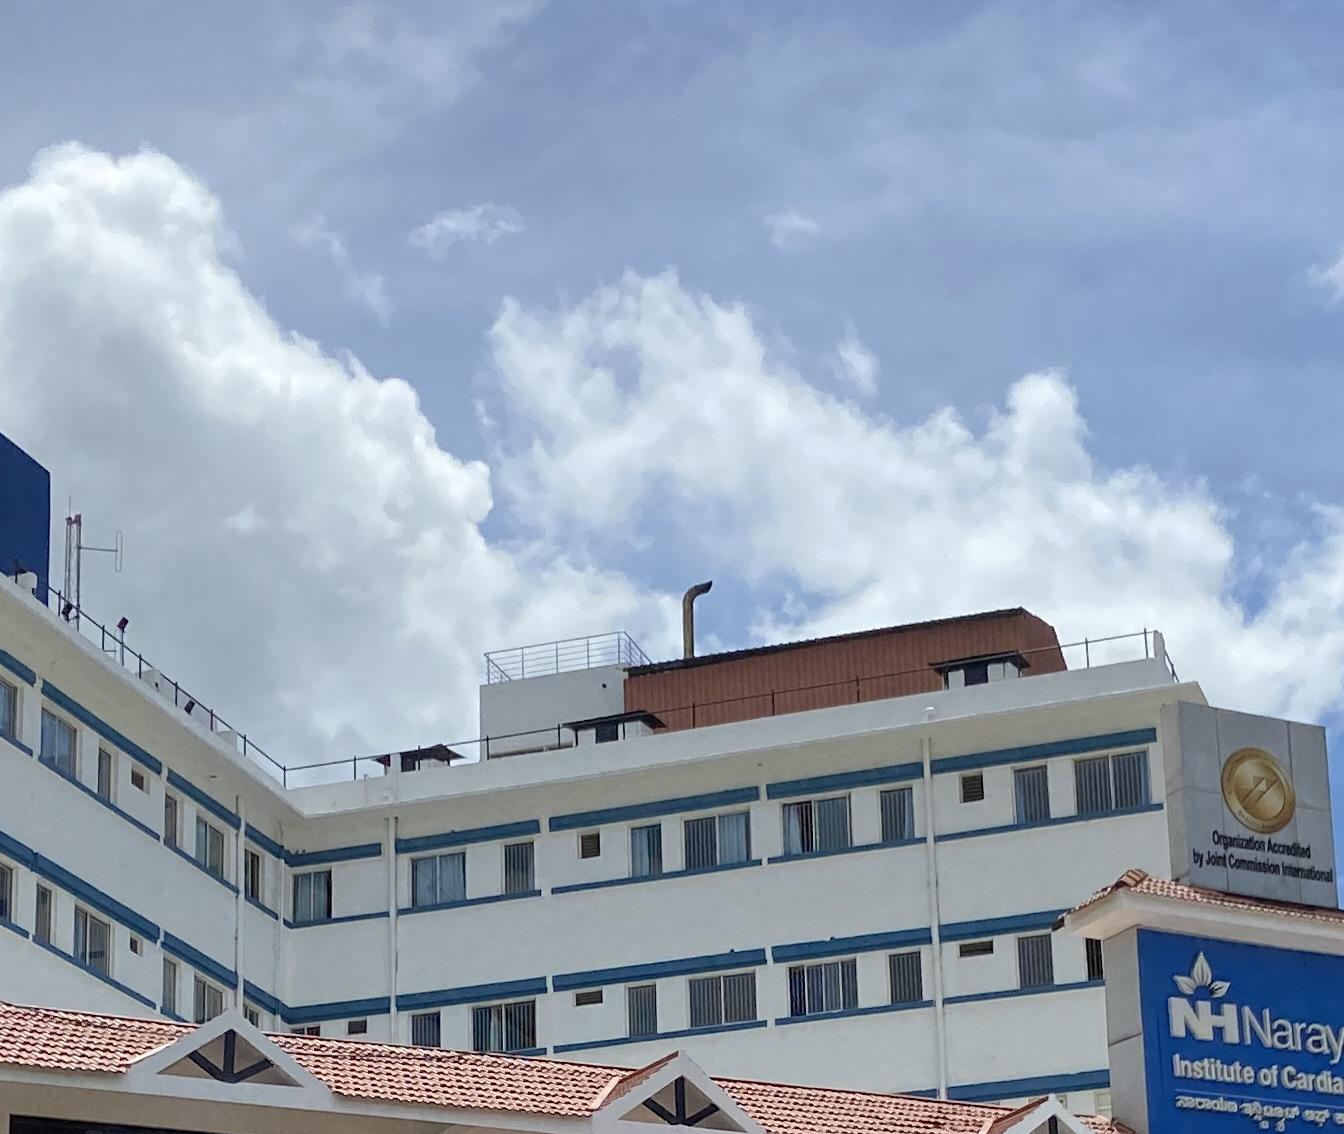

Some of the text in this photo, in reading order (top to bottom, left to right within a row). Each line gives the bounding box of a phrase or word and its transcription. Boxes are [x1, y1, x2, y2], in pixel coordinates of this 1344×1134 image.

[1212, 830, 1311, 859] Organization Accredited
[1192, 848, 1333, 883] by Joint Commission International
[1167, 996, 1240, 1045] NH
[1172, 1053, 1255, 1084] Institute
[1258, 1064, 1278, 1087] of
